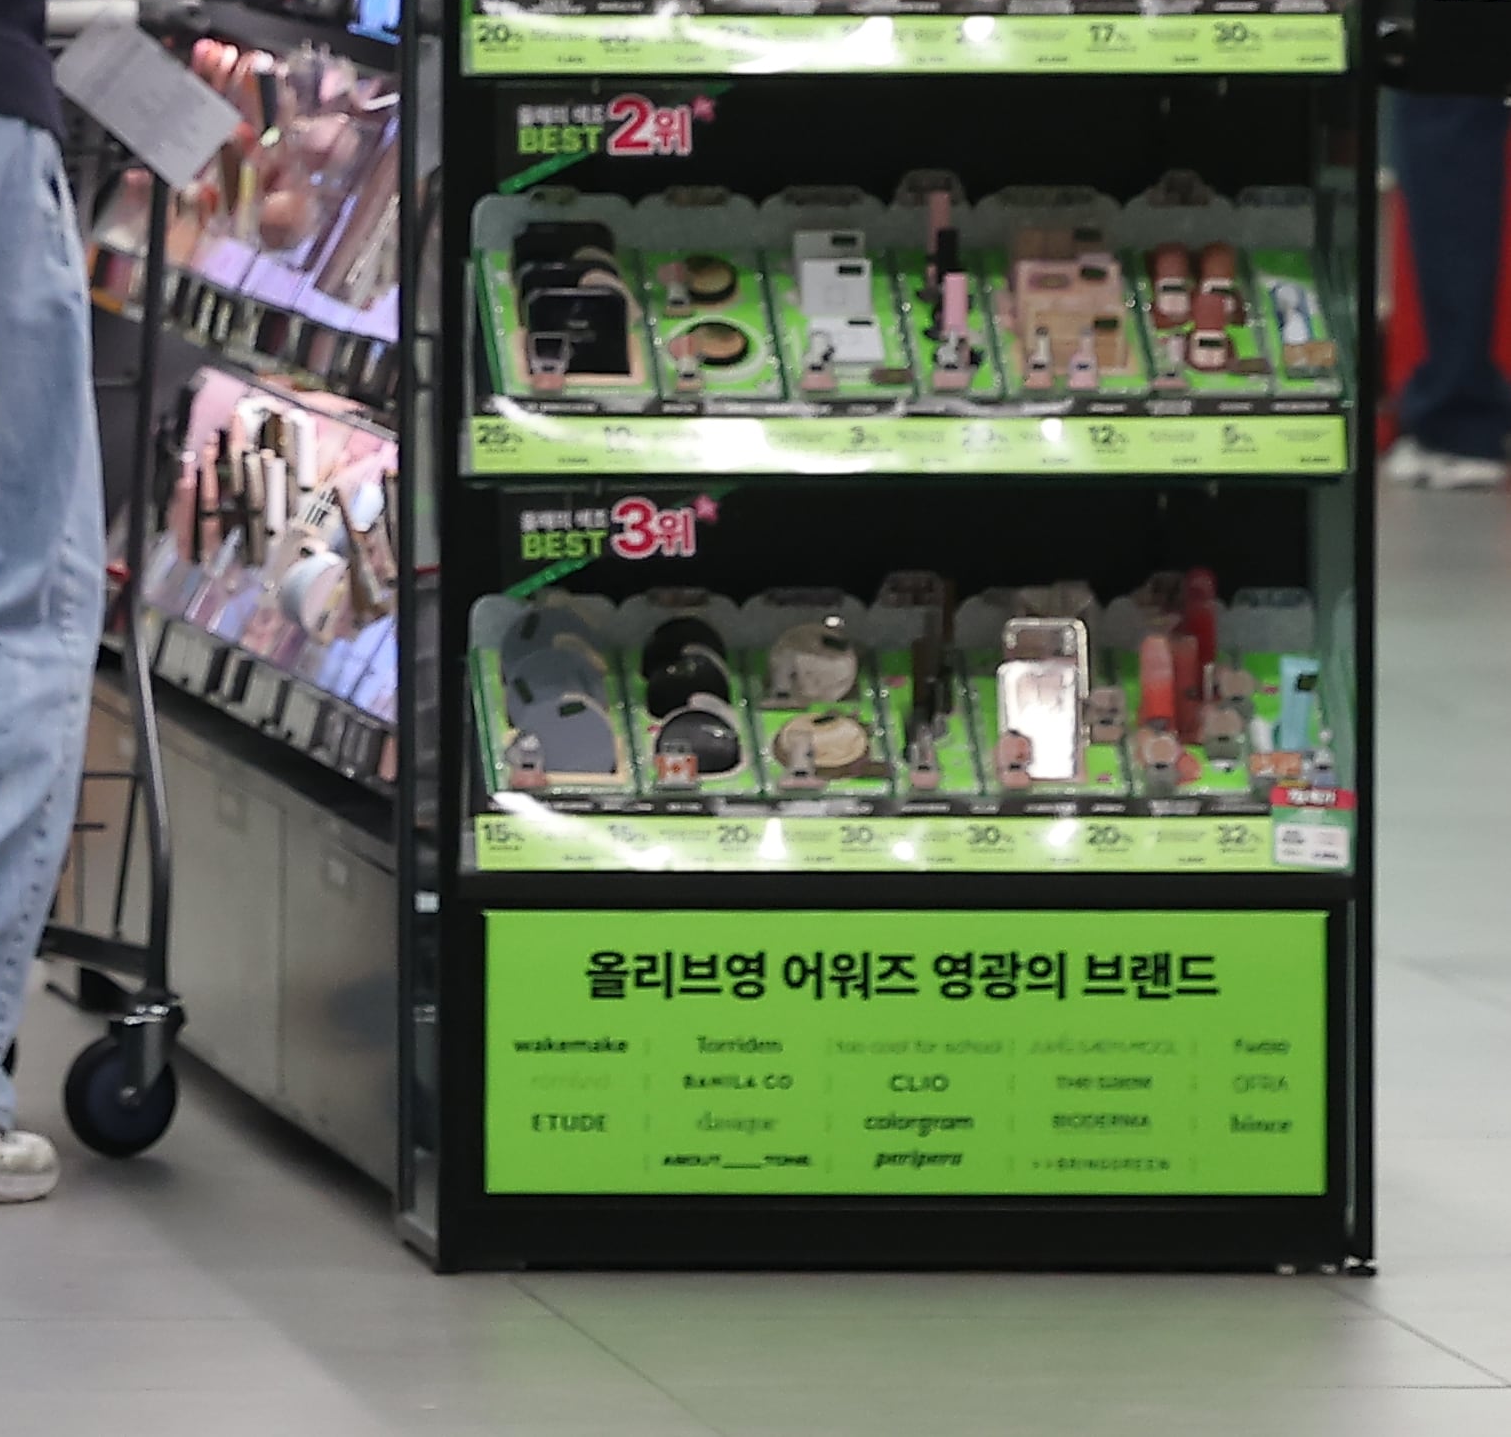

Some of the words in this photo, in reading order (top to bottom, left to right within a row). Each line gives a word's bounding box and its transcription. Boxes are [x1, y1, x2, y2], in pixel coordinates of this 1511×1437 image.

[518, 126, 603, 154] BEST
[522, 529, 606, 559] BEST
[586, 950, 768, 1001] 올리브영
[782, 950, 920, 1001] 어워즈
[933, 950, 1067, 1001] 영광의
[1082, 950, 1221, 1001] 브랜드
